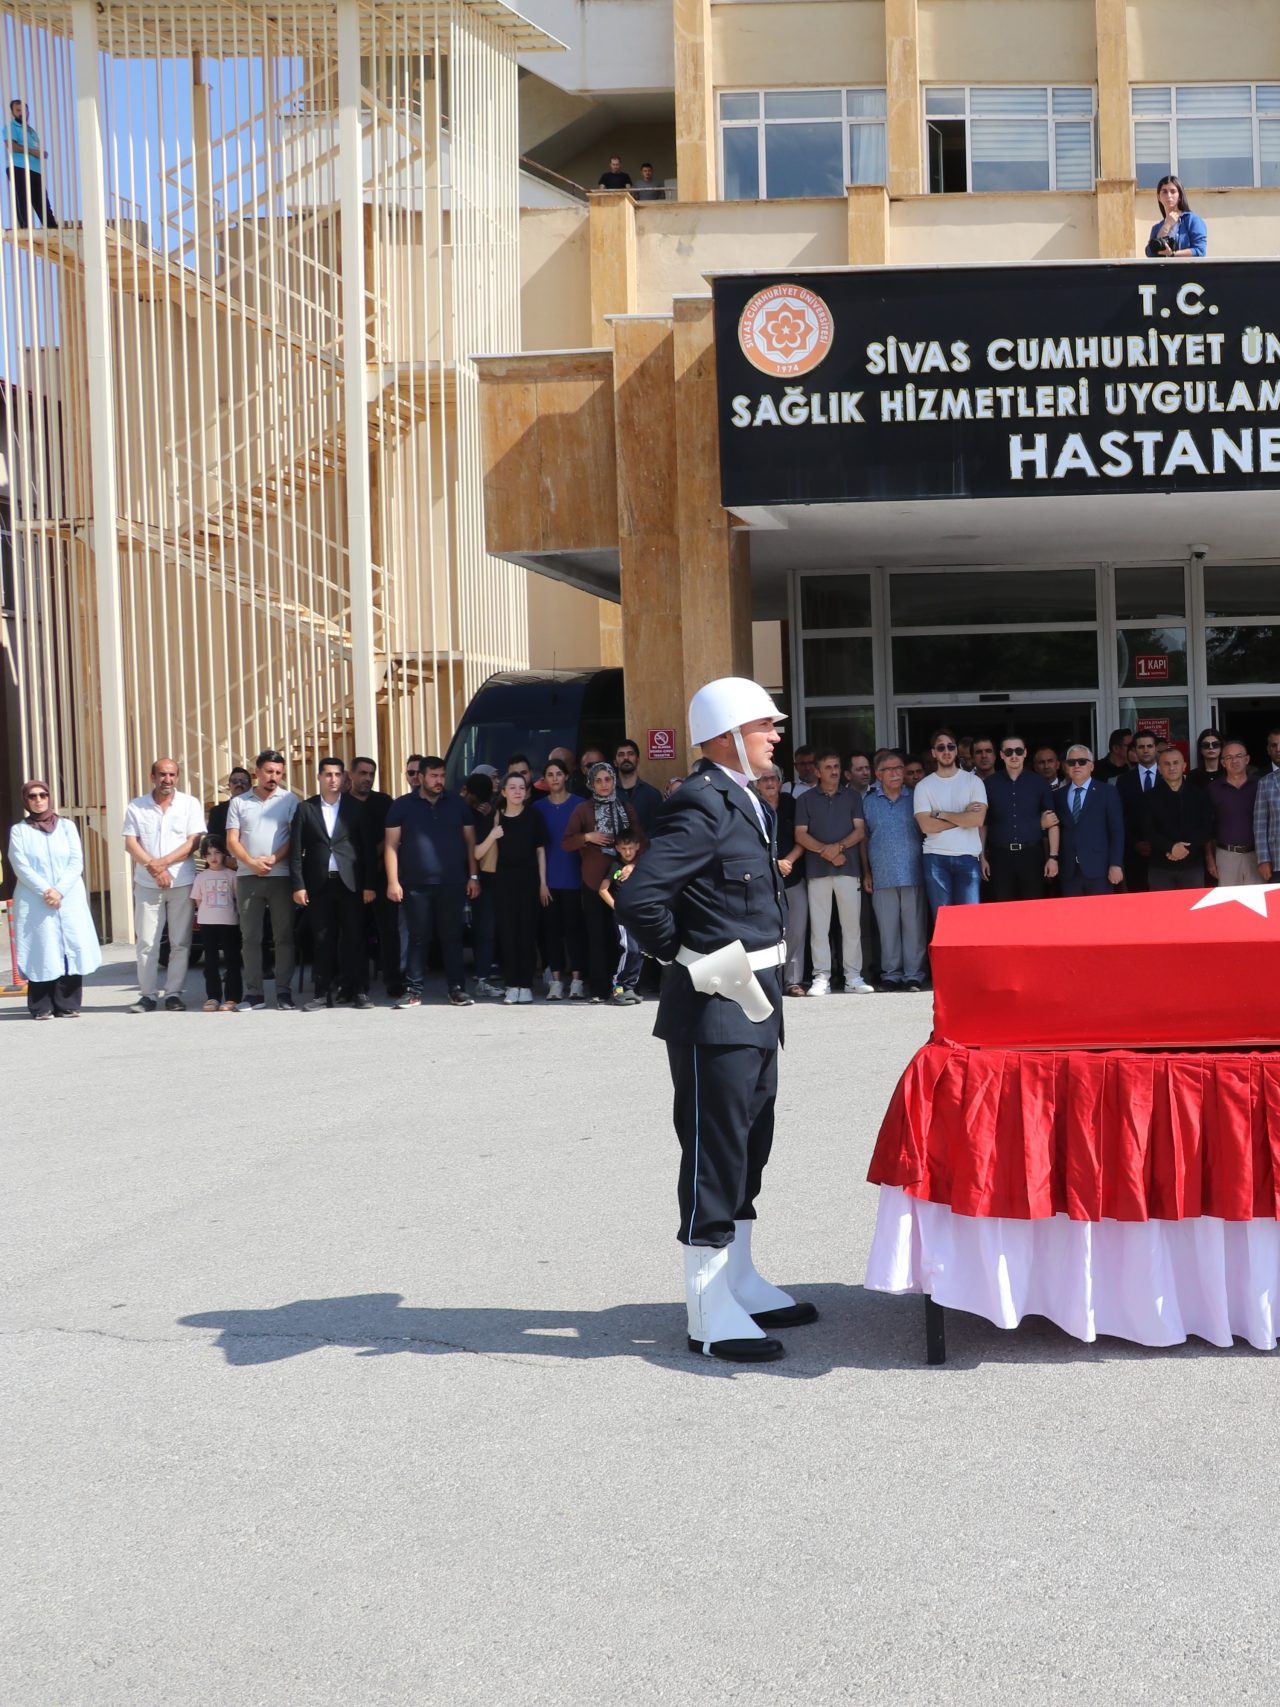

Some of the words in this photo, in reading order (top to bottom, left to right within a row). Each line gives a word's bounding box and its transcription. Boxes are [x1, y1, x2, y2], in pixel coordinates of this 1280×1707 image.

[746, 286, 797, 318] CUMHURİYET
[1138, 282, 1219, 318] T.C.
[865, 335, 971, 375] SİVAS
[986, 327, 1225, 371] CUMHURİYET
[776, 364, 799, 373] 1974
[731, 386, 866, 427] SAĞLIK
[880, 377, 1090, 422] HİZMETLERİ
[1138, 659, 1150, 675] 1.
[1148, 659, 1166, 669] KAPI
